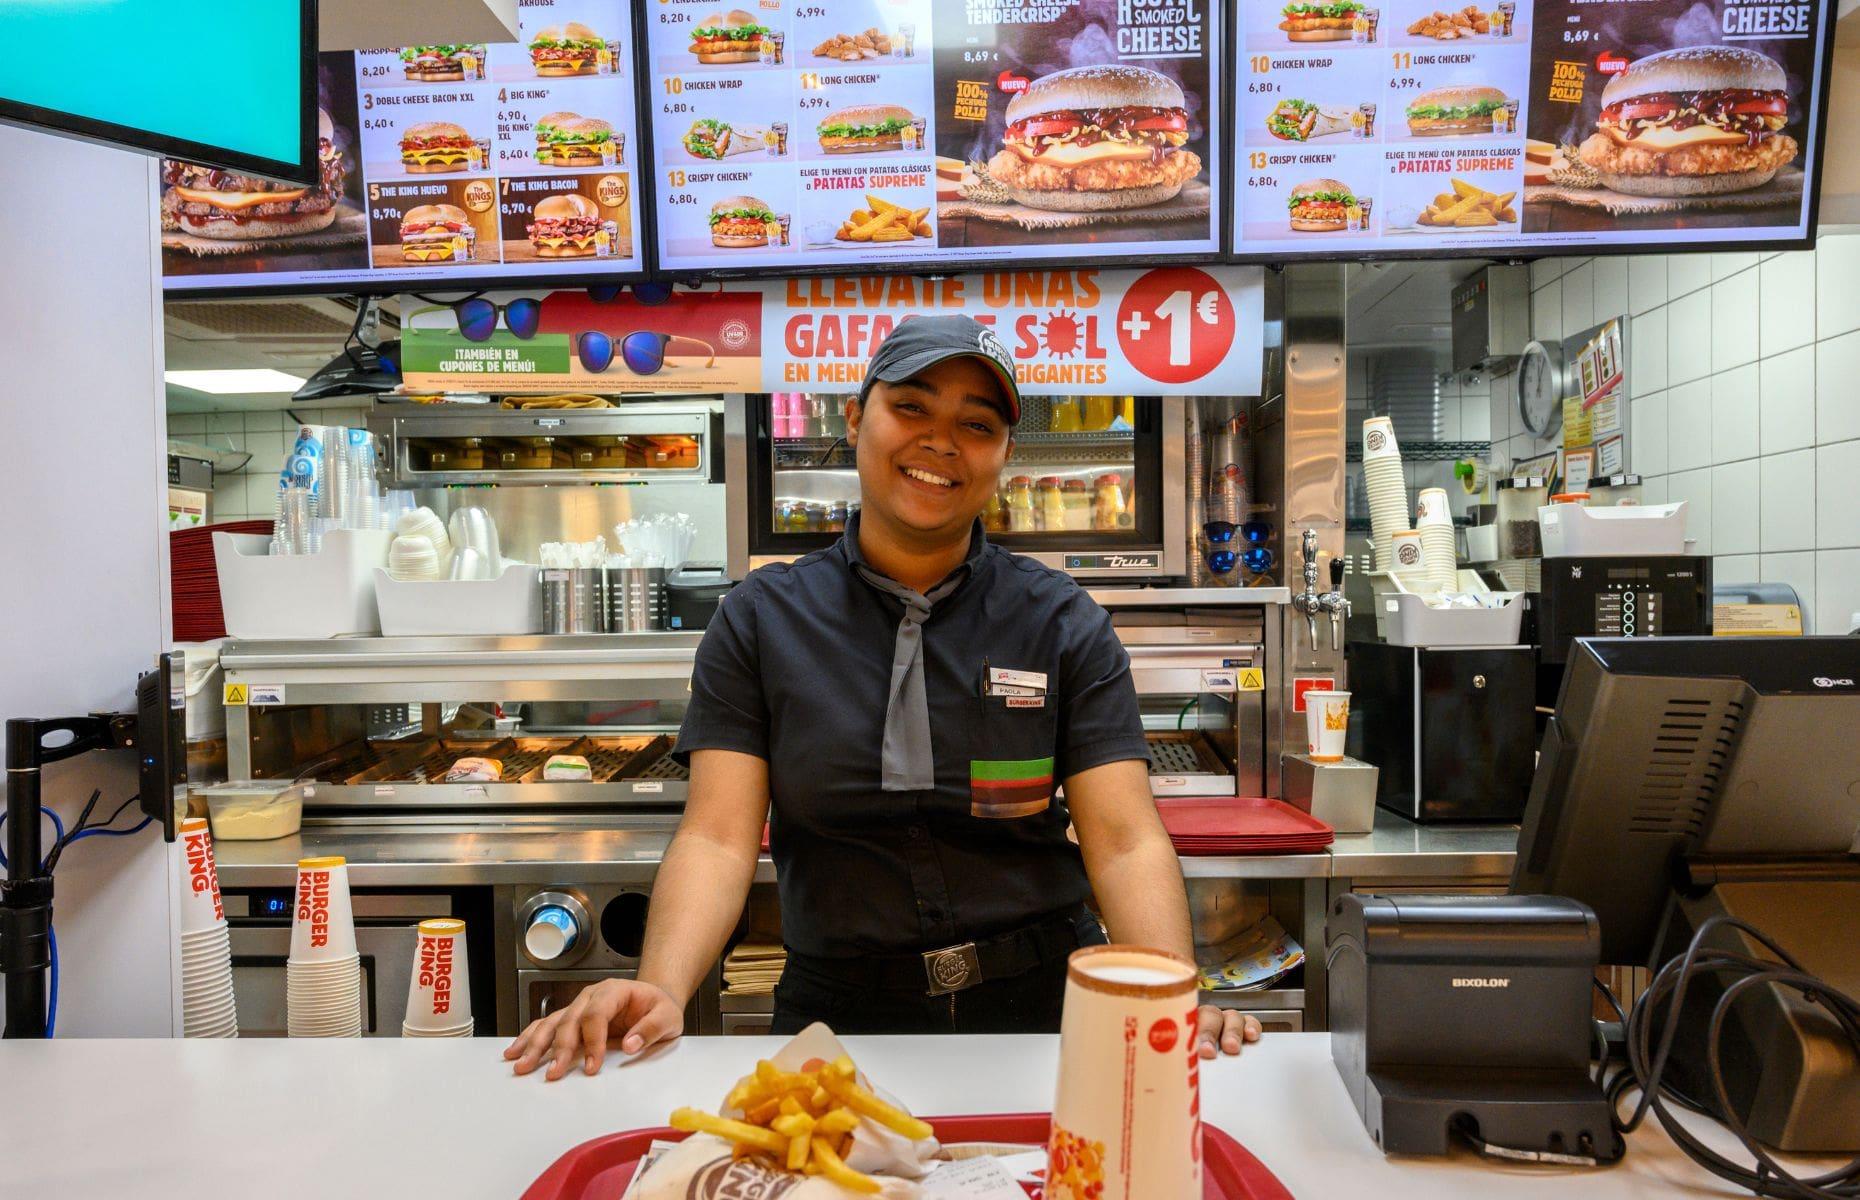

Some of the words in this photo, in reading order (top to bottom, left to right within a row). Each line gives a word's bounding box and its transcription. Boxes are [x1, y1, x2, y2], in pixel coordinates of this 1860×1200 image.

[1134, 8, 1186, 25] SMOKED
[1722, 6, 1809, 33] CHEESE
[1117, 25, 1201, 53] CHEESE
[1250, 56, 1270, 73] 10
[1272, 59, 1305, 69] CHICKEN
[1307, 58, 1333, 68] WRAP
[1391, 52, 1411, 69] 11
[1413, 55, 1435, 65] LONG
[1553, 64, 1585, 81] 100%
[664, 78, 682, 95] 10
[684, 81, 716, 91] CHICKEN
[719, 80, 743, 90] WRAP
[800, 73, 821, 90] 11
[821, 76, 842, 85] LONG
[498, 88, 508, 103] 4
[511, 91, 525, 100] BIG
[956, 83, 988, 98] 100%
[1549, 87, 1583, 100] POLLO
[364, 93, 374, 109] 3
[376, 96, 400, 106] DOBLE
[403, 95, 430, 105] CHEESE
[432, 94, 458, 103] BACON
[460, 93, 474, 102] XXL
[954, 104, 987, 118] POLLO
[498, 124, 511, 133] BIG
[498, 132, 511, 141] XXL
[1248, 152, 1267, 169] 13
[1269, 155, 1297, 165] CRISPY
[1385, 151, 1405, 160] ELIGE
[1407, 151, 1416, 159] TU
[1441, 149, 1455, 158] CON
[1457, 148, 1488, 157] PATATAS
[800, 168, 819, 177] ELIGE
[821, 168, 830, 176] TU
[854, 166, 867, 175] CON
[869, 165, 899, 174] PATATAS
[1398, 159, 1451, 173] PATATAS
[1456, 158, 1514, 172] SUPREME
[500, 179, 510, 196] 7
[511, 181, 526, 192] THE
[528, 180, 548, 190] KING
[550, 179, 578, 190] BACON
[667, 170, 686, 188] 13
[688, 173, 714, 183] CRISPY
[813, 176, 865, 190] PATATAS
[869, 175, 926, 189] SUPREME
[370, 185, 380, 201] 5
[381, 187, 396, 197] THE
[398, 186, 418, 196] KING
[420, 185, 448, 195] HUEVO
[466, 191, 492, 202] KINGS
[599, 186, 624, 197] KINGS
[983, 270, 1101, 307] UNAS
[784, 313, 921, 358] GAFA
[505, 349, 519, 361] EN
[439, 361, 484, 373] CUPONES
[487, 361, 500, 372] DE
[502, 359, 537, 372] MENÚ!
[784, 362, 810, 382] EN
[1014, 364, 1107, 384] GIGANTES
[1000, 687, 1021, 695] PAOLA
[184, 835, 209, 894] KING
[202, 832, 225, 921] BURGER
[297, 871, 312, 921] KING
[310, 871, 330, 948] BURGER
[419, 937, 436, 987] KING
[432, 937, 454, 1015] BURGER
[1452, 978, 1511, 987] BIXOLON
